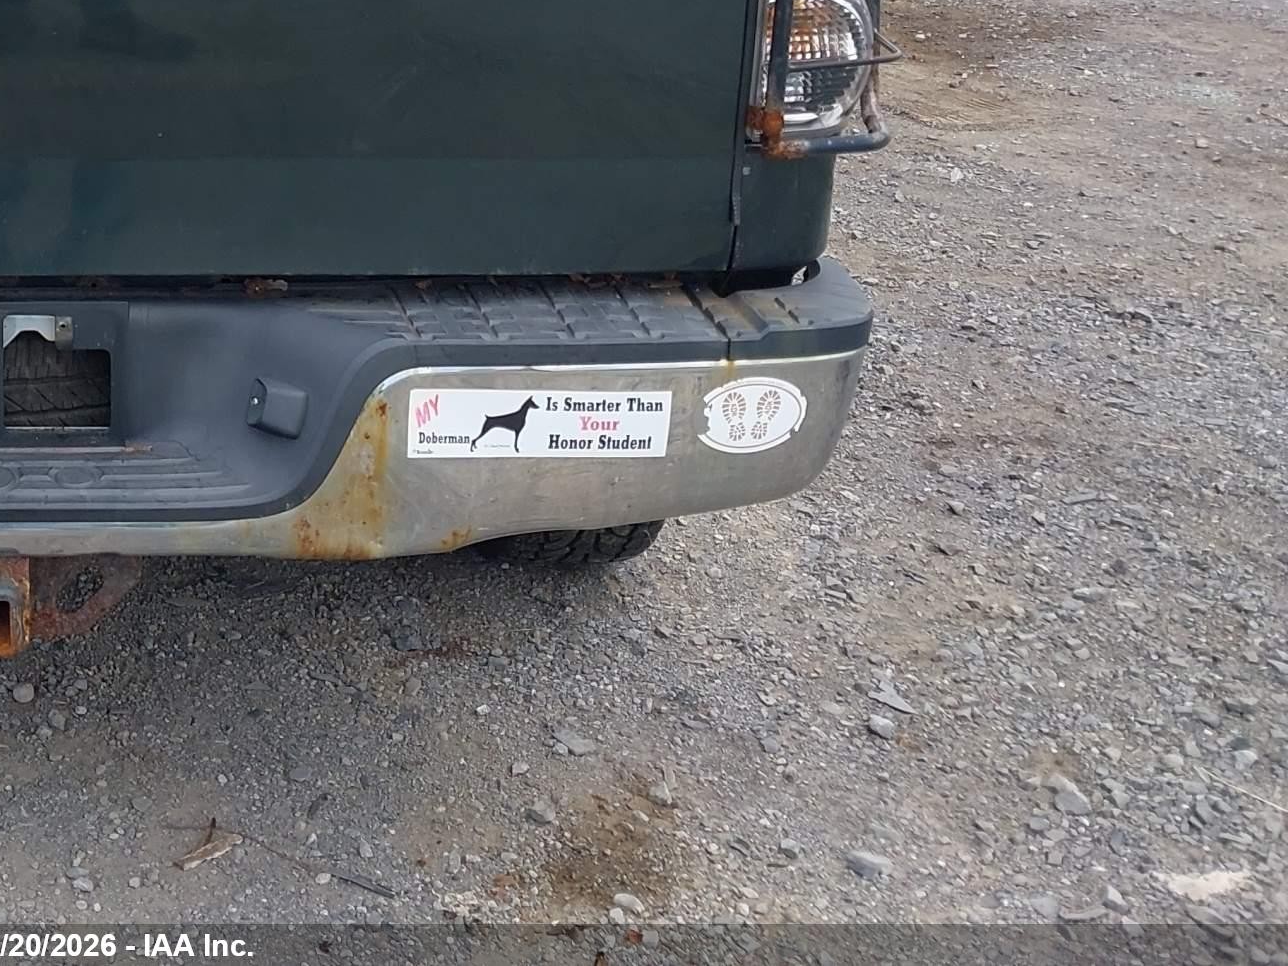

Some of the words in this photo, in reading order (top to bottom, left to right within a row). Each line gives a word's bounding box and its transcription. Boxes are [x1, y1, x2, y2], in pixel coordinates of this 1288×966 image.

[415, 393, 440, 428] MY
[545, 396, 559, 412] Is
[563, 396, 622, 413] Smarter
[626, 397, 664, 413] Than
[579, 416, 621, 431] Your
[418, 431, 471, 445] Doberman
[547, 433, 594, 450] Honor
[597, 434, 653, 450] Student
